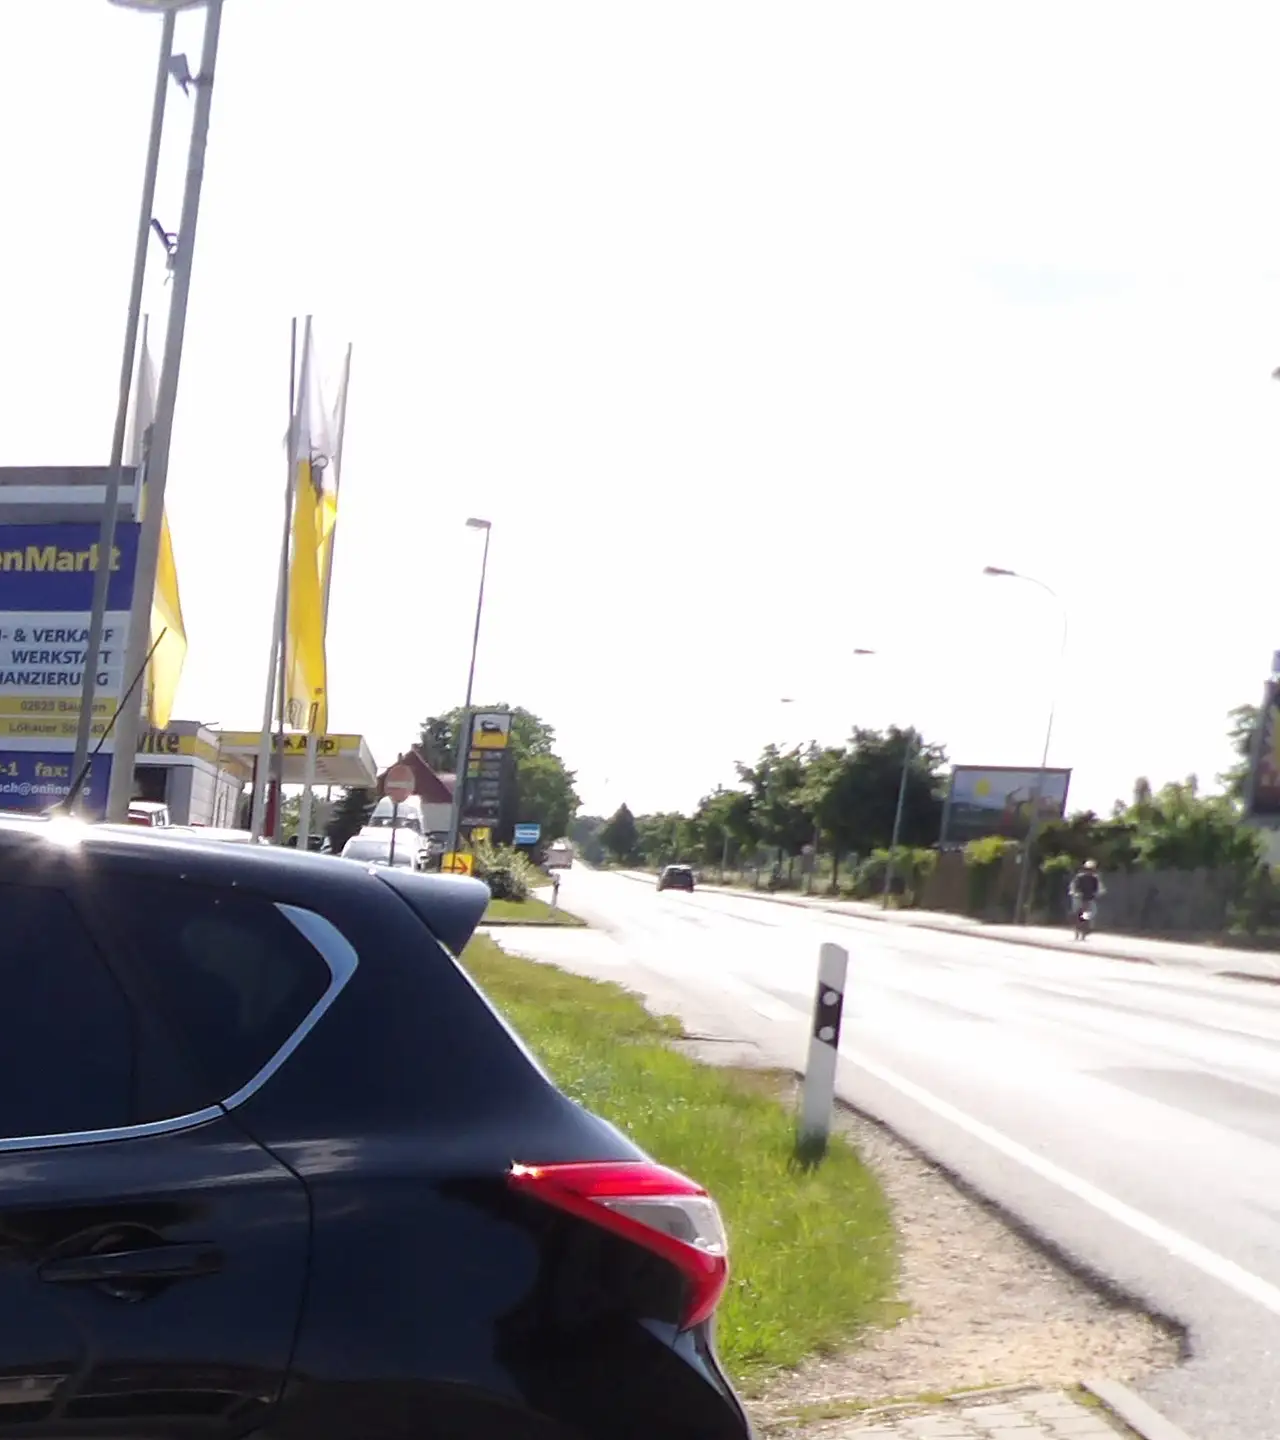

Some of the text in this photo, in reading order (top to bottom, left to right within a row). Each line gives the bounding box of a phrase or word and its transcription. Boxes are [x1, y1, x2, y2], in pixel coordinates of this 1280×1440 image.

[13, 628, 27, 643] &
[33, 628, 115, 644] VERKAF
[11, 650, 112, 665] WERKSTAT
[58, 701, 107, 713] Bauen
